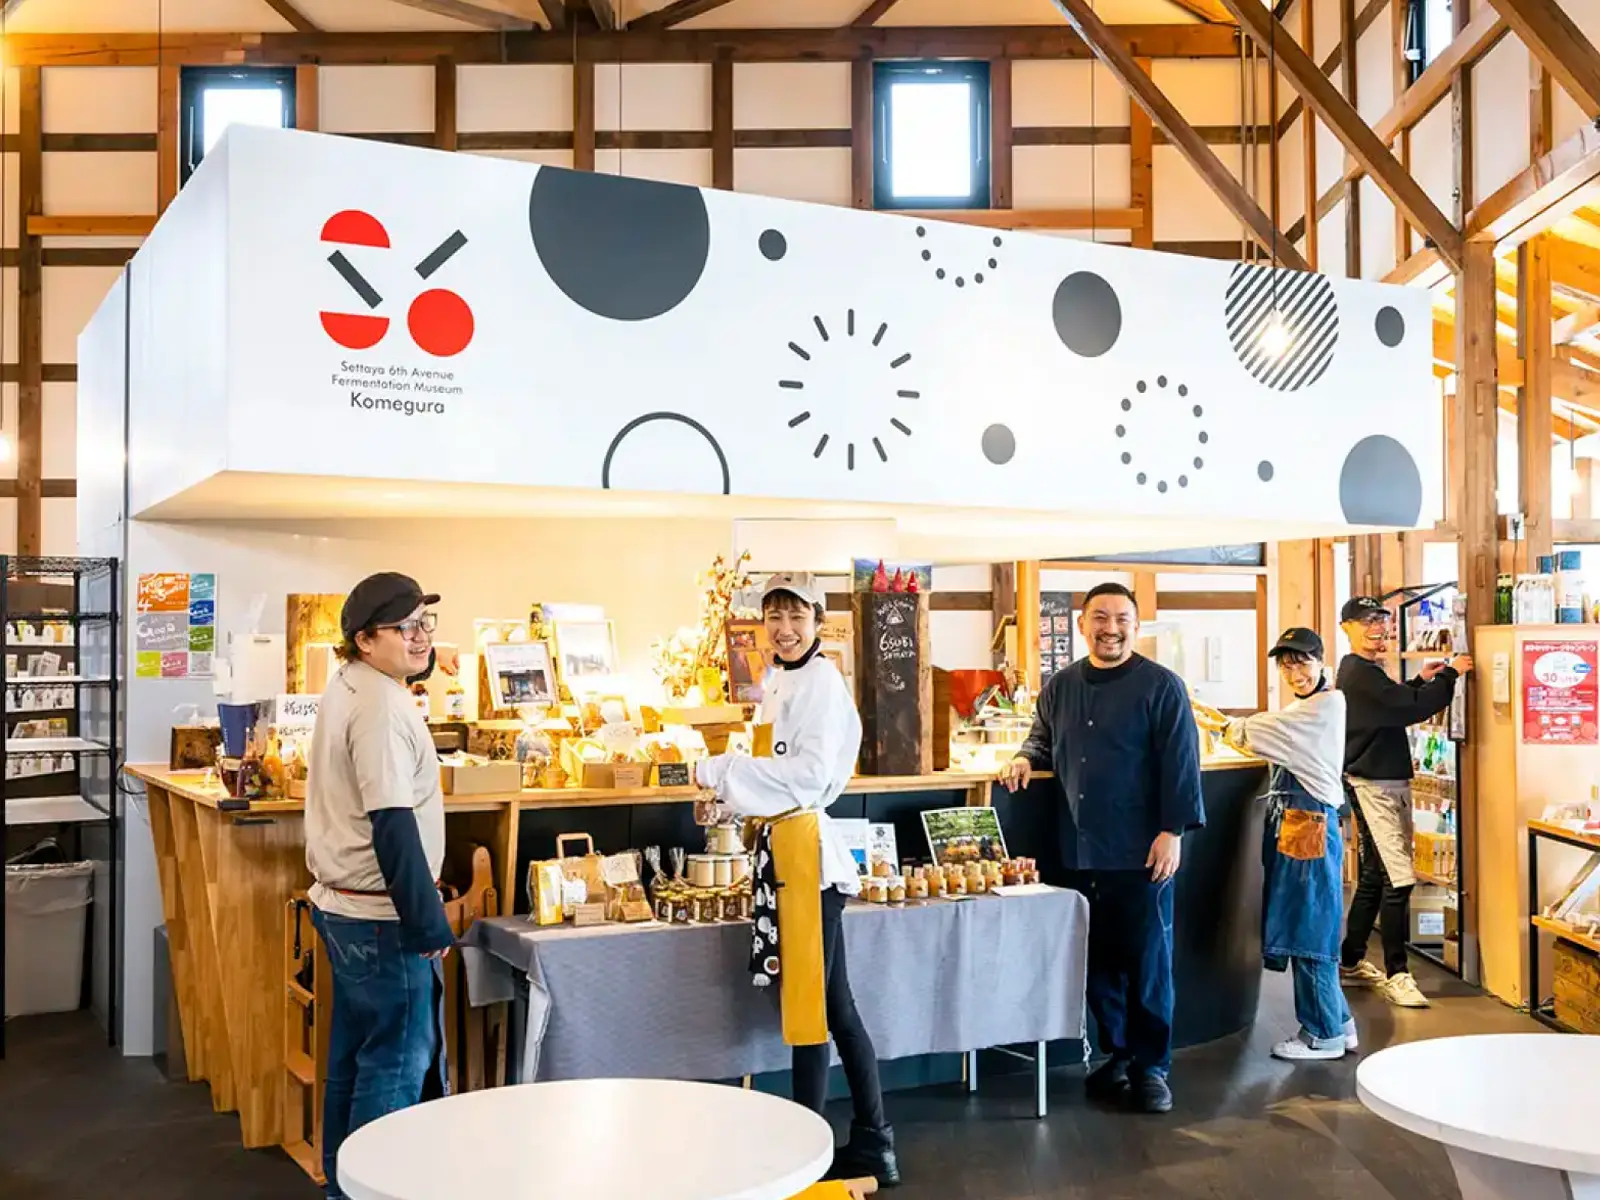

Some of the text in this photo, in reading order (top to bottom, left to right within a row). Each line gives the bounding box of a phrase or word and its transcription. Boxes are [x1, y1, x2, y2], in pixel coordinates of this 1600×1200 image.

[341, 360, 454, 381] Settaya 6th Avenue
[331, 374, 463, 395] Fermentation Museum
[351, 391, 445, 416] Komegura
